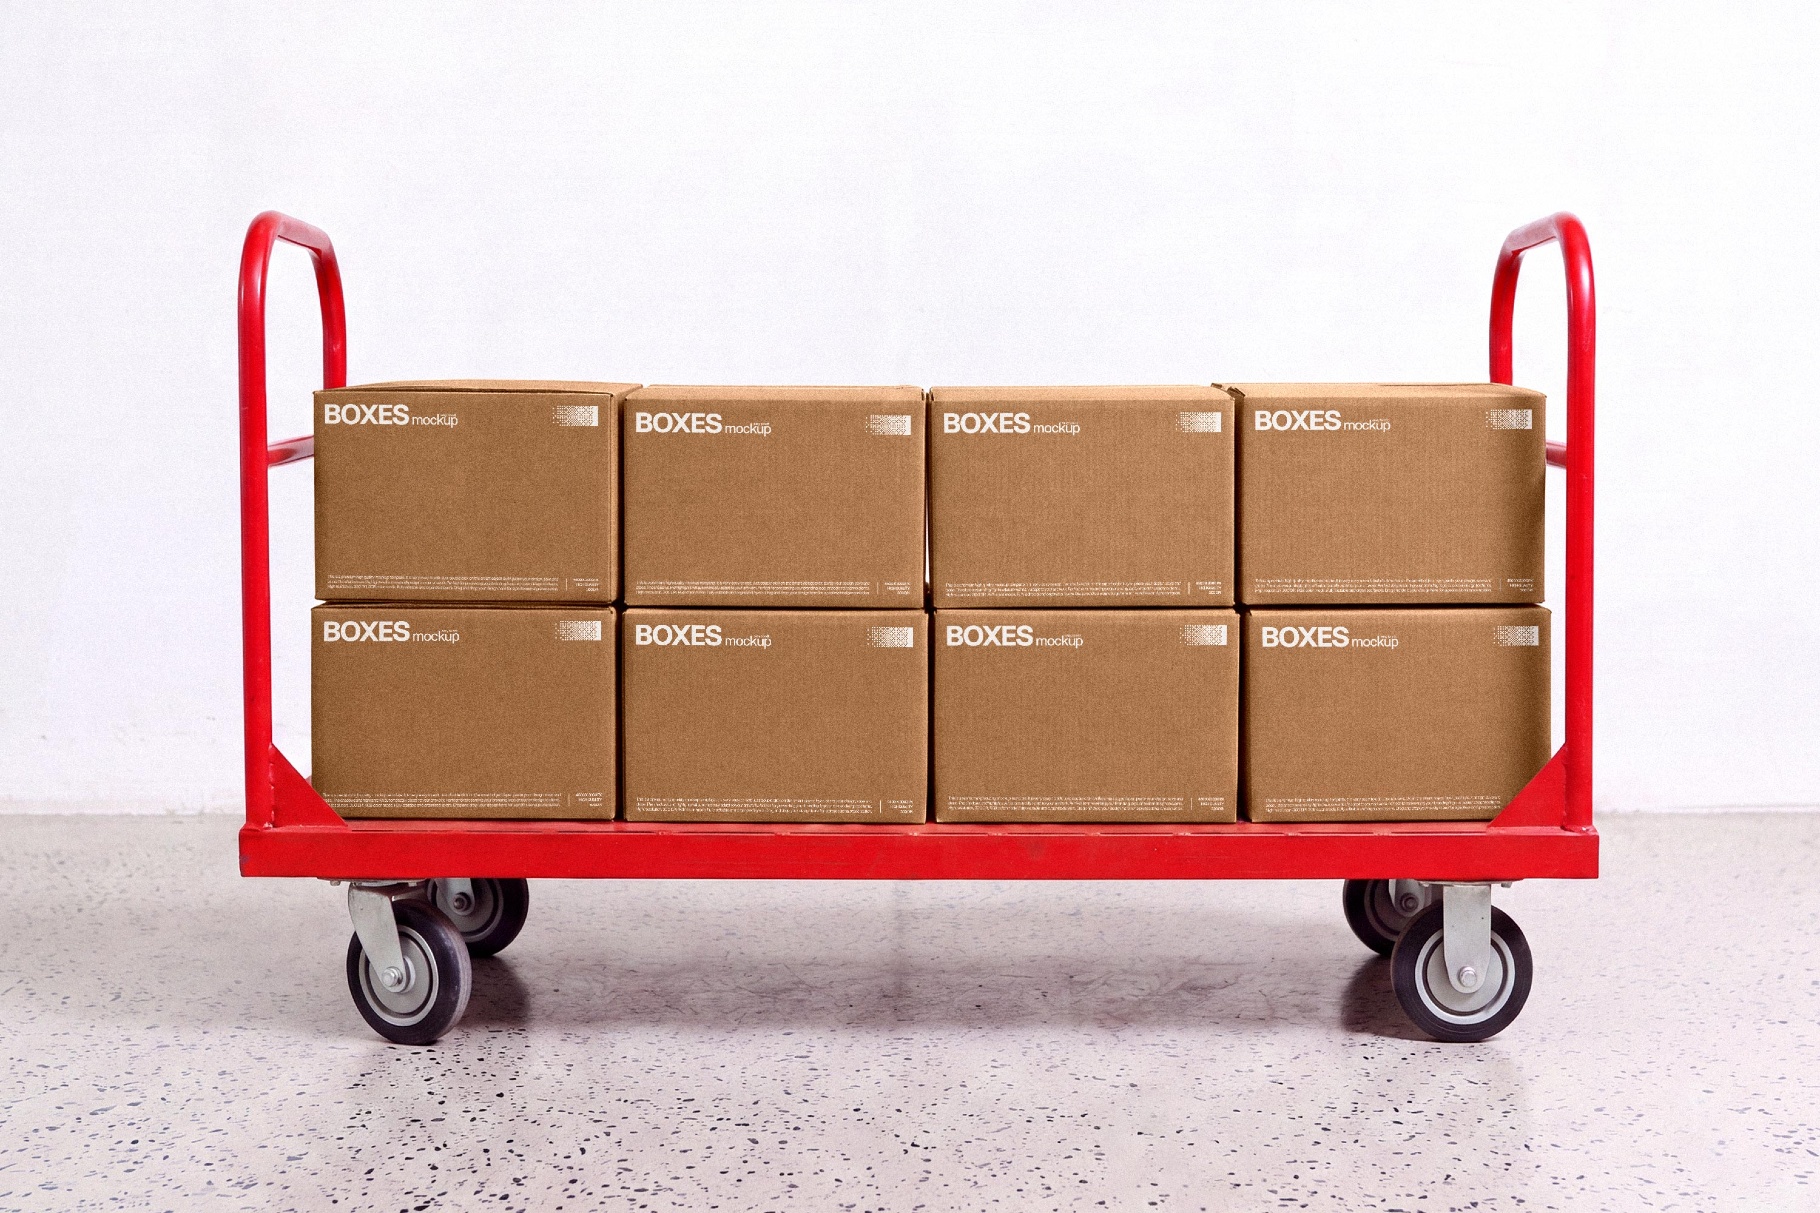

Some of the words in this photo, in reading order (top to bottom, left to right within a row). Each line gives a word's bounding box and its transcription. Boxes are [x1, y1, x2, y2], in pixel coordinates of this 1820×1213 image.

[324, 404, 409, 426] BOXES
[411, 412, 458, 427] mockup
[635, 412, 722, 434] BOXES
[724, 421, 771, 436] mockup
[943, 412, 1031, 434] BOXES
[1033, 421, 1080, 435] mockup
[1254, 410, 1342, 432] BOXES
[1343, 418, 1391, 433] mockup
[323, 621, 410, 642] BOXES
[412, 628, 459, 643] mockup
[635, 625, 722, 647] BOXES
[724, 633, 771, 648] mockup
[946, 625, 1033, 647] BOXES
[1035, 633, 1083, 648] mockup
[1261, 626, 1349, 648] BOXES
[1351, 634, 1399, 649] mockup
